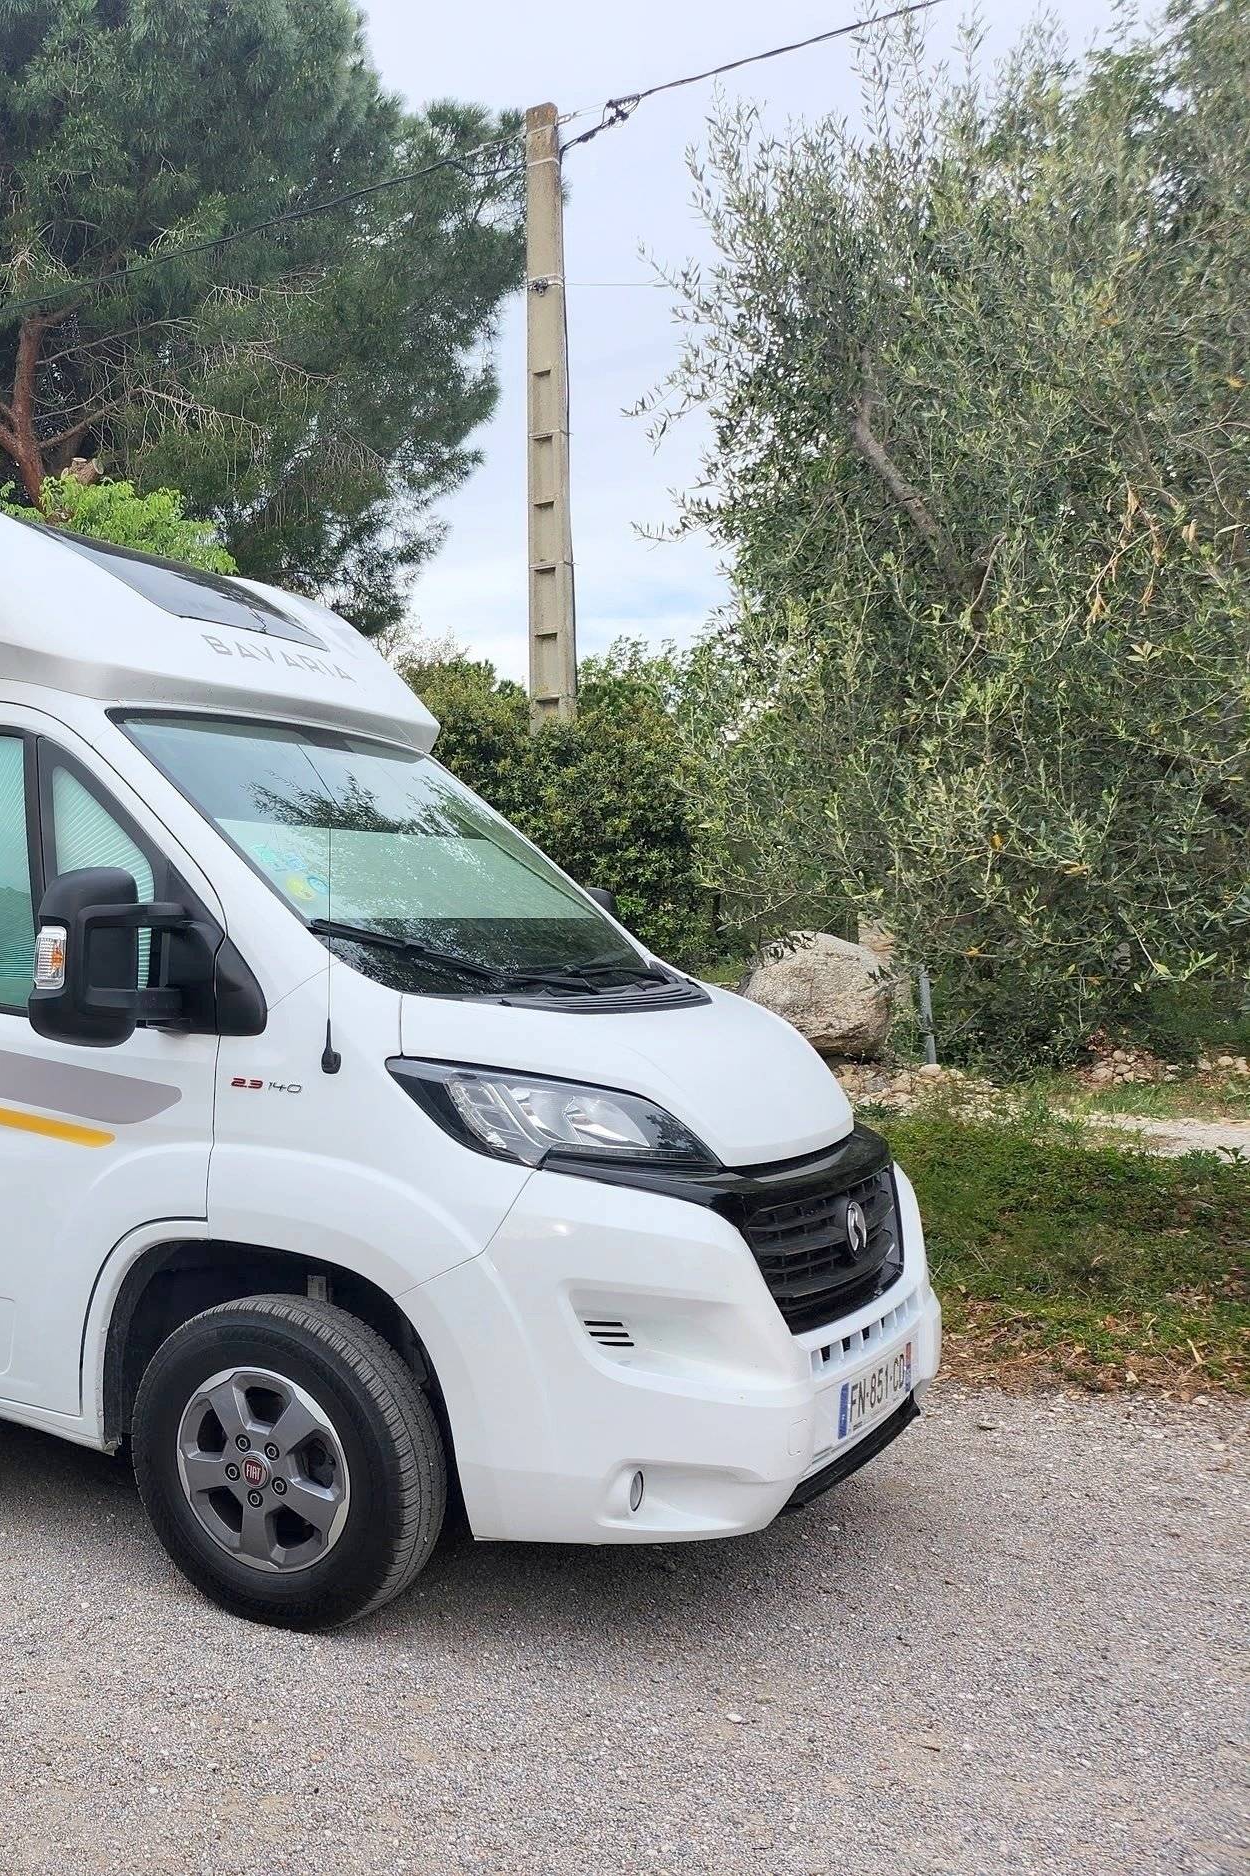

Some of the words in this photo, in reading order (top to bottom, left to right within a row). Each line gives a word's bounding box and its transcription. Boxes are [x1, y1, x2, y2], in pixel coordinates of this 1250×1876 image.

[200, 634, 357, 683] BAVARIA
[268, 1082, 302, 1093] 140
[246, 1464, 261, 1481] FIAT
